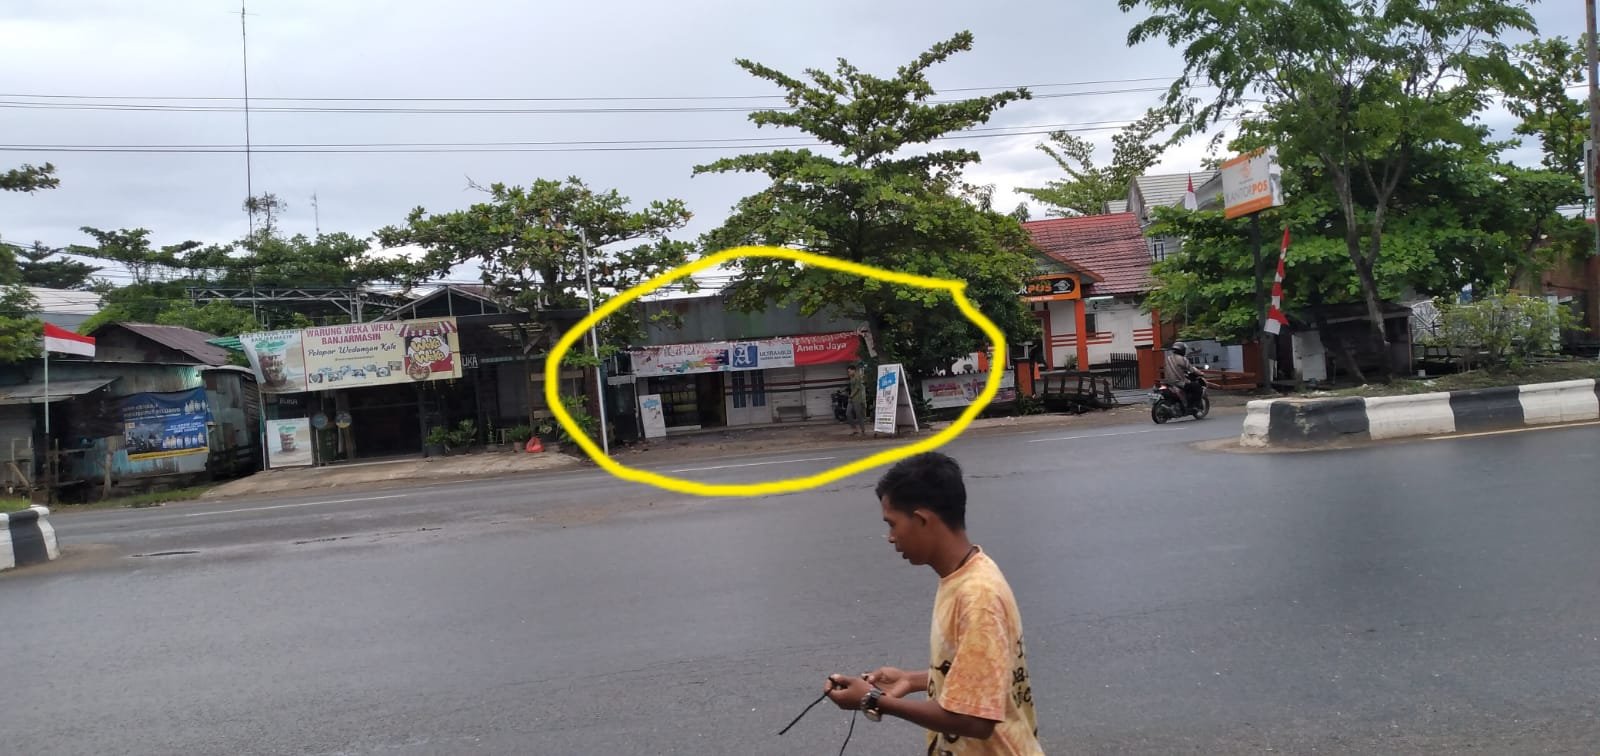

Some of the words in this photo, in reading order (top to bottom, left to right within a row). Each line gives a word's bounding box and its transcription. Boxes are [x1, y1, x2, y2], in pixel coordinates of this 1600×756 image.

[306, 327, 342, 338] WARUNG
[344, 325, 368, 334] WEKA
[370, 323, 395, 332] WEKA
[321, 333, 381, 345] BANJARMASIN
[797, 343, 825, 353] Aneka
[826, 341, 847, 351] Jaya
[462, 355, 479, 367] UKA
